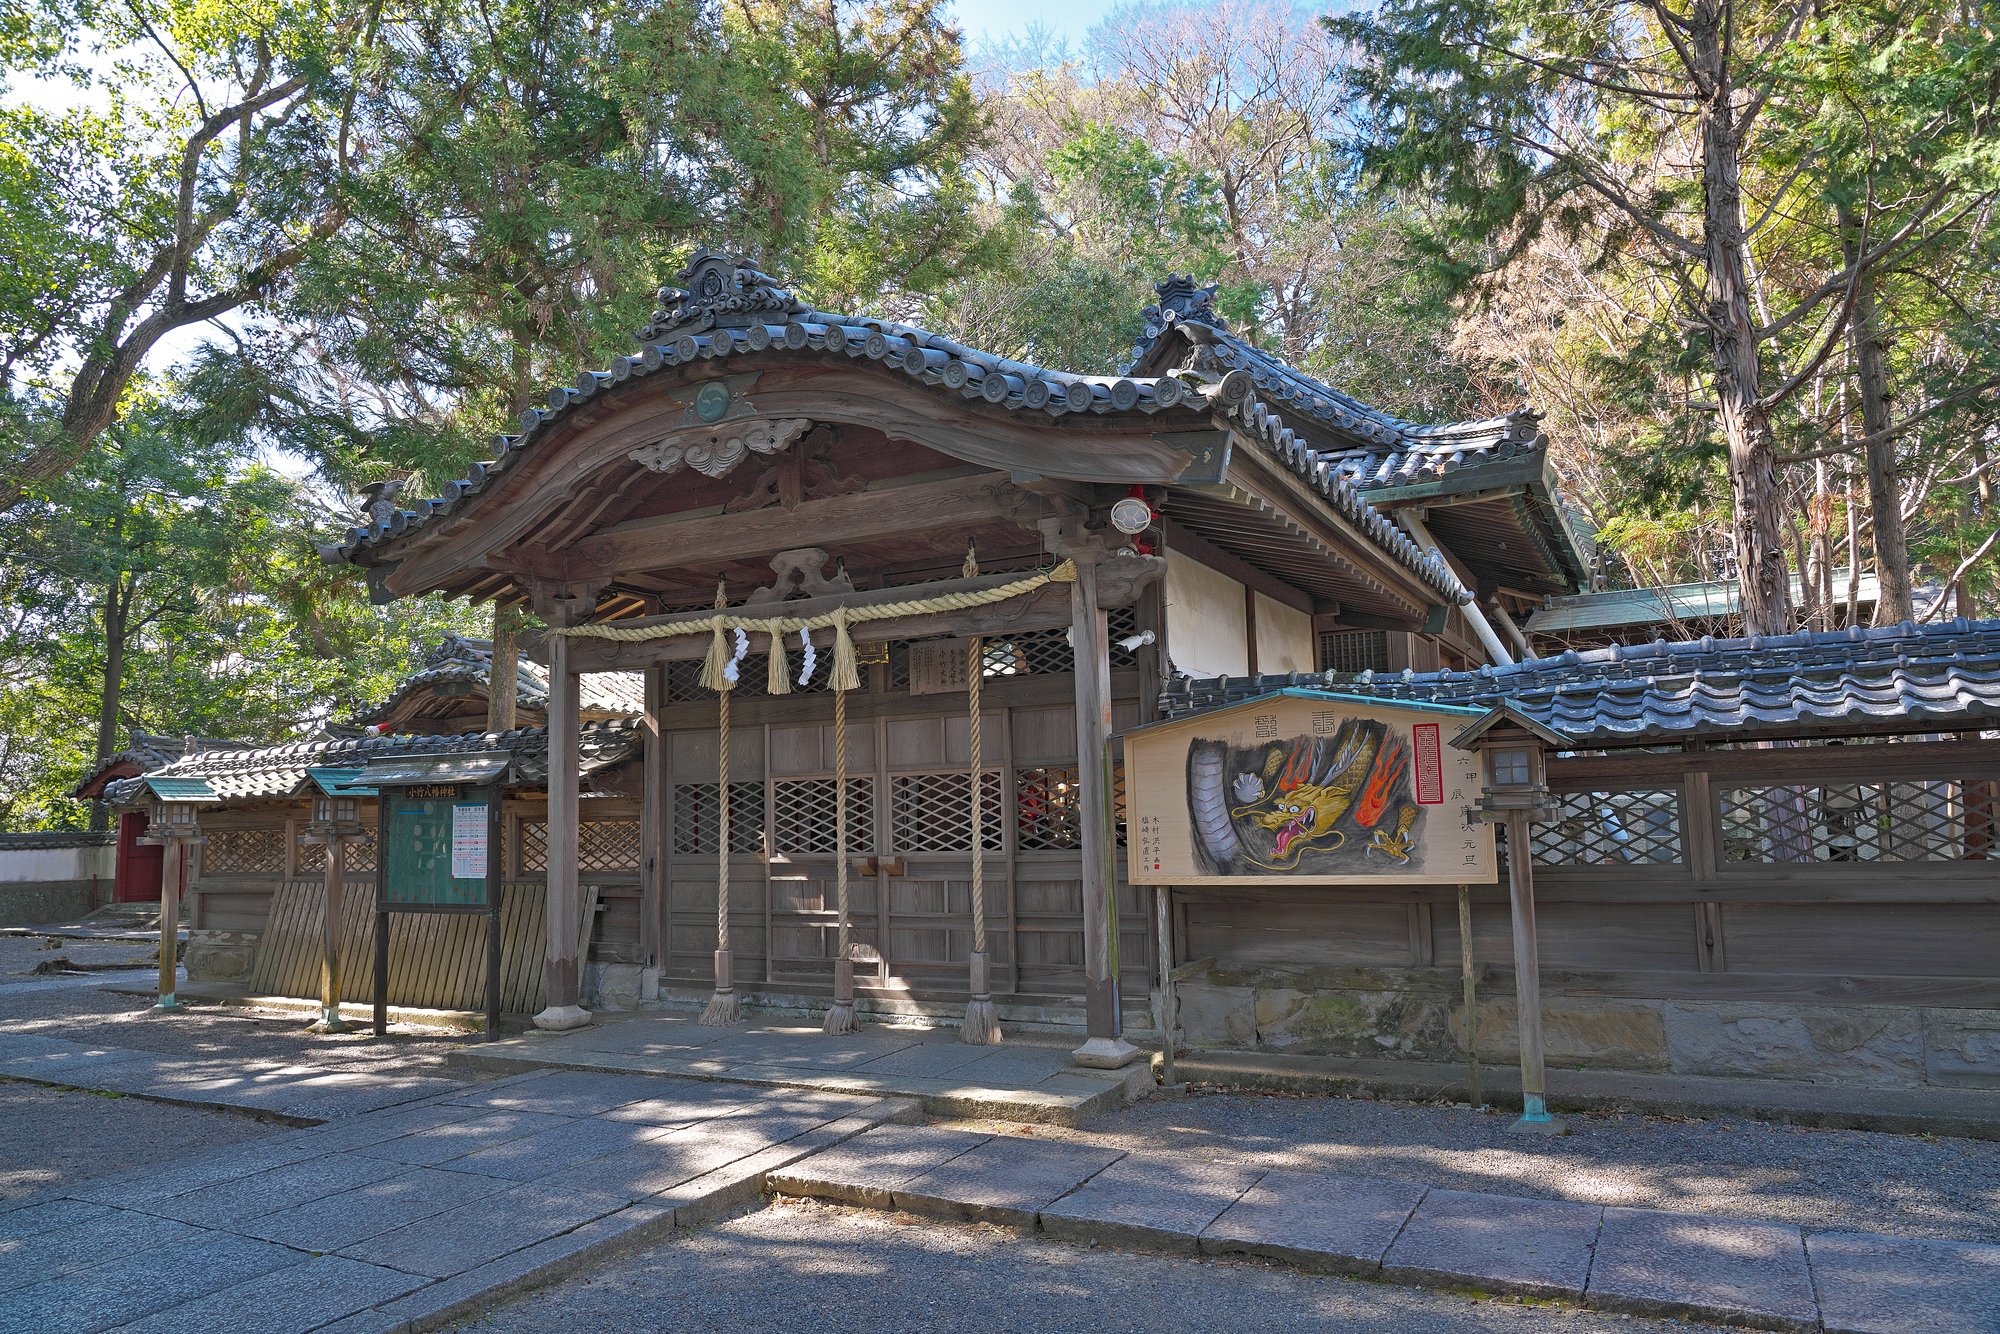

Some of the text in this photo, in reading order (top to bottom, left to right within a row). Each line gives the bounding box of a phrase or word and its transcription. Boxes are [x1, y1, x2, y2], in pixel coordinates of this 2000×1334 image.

[408, 785, 456, 798] 小竹八幡神社
